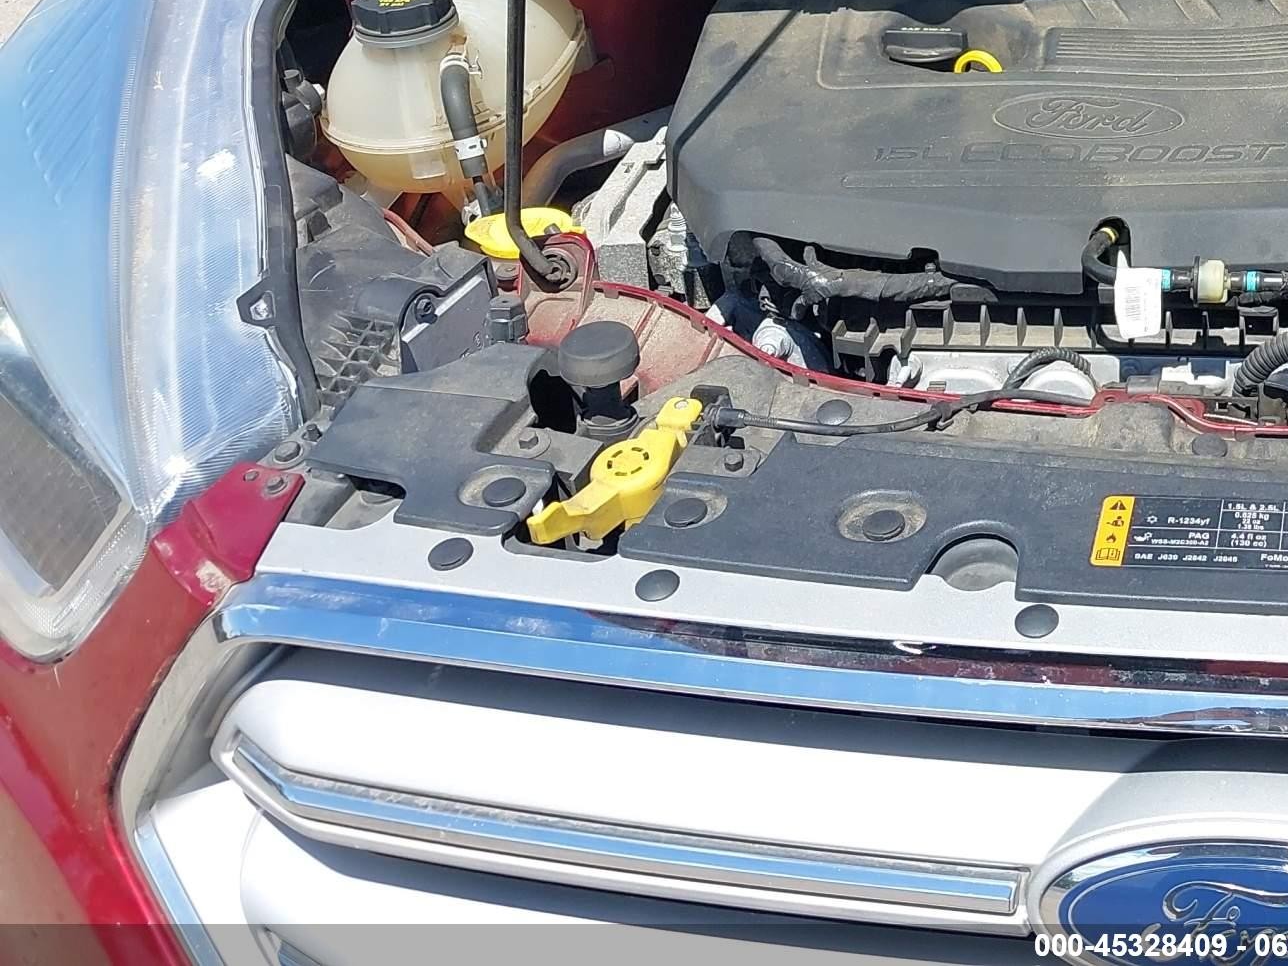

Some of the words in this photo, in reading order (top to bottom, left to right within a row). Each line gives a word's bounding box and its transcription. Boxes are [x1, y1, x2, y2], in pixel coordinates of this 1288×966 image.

[1026, 96, 1152, 134] Ford
[961, 141, 1287, 164] ECOBOOST
[1167, 516, 1211, 526] R-1234yf
[1258, 513, 1270, 521] kg
[1188, 531, 1210, 540] PAG
[1252, 540, 1268, 548] cc)
[1134, 552, 1153, 560] SAE
